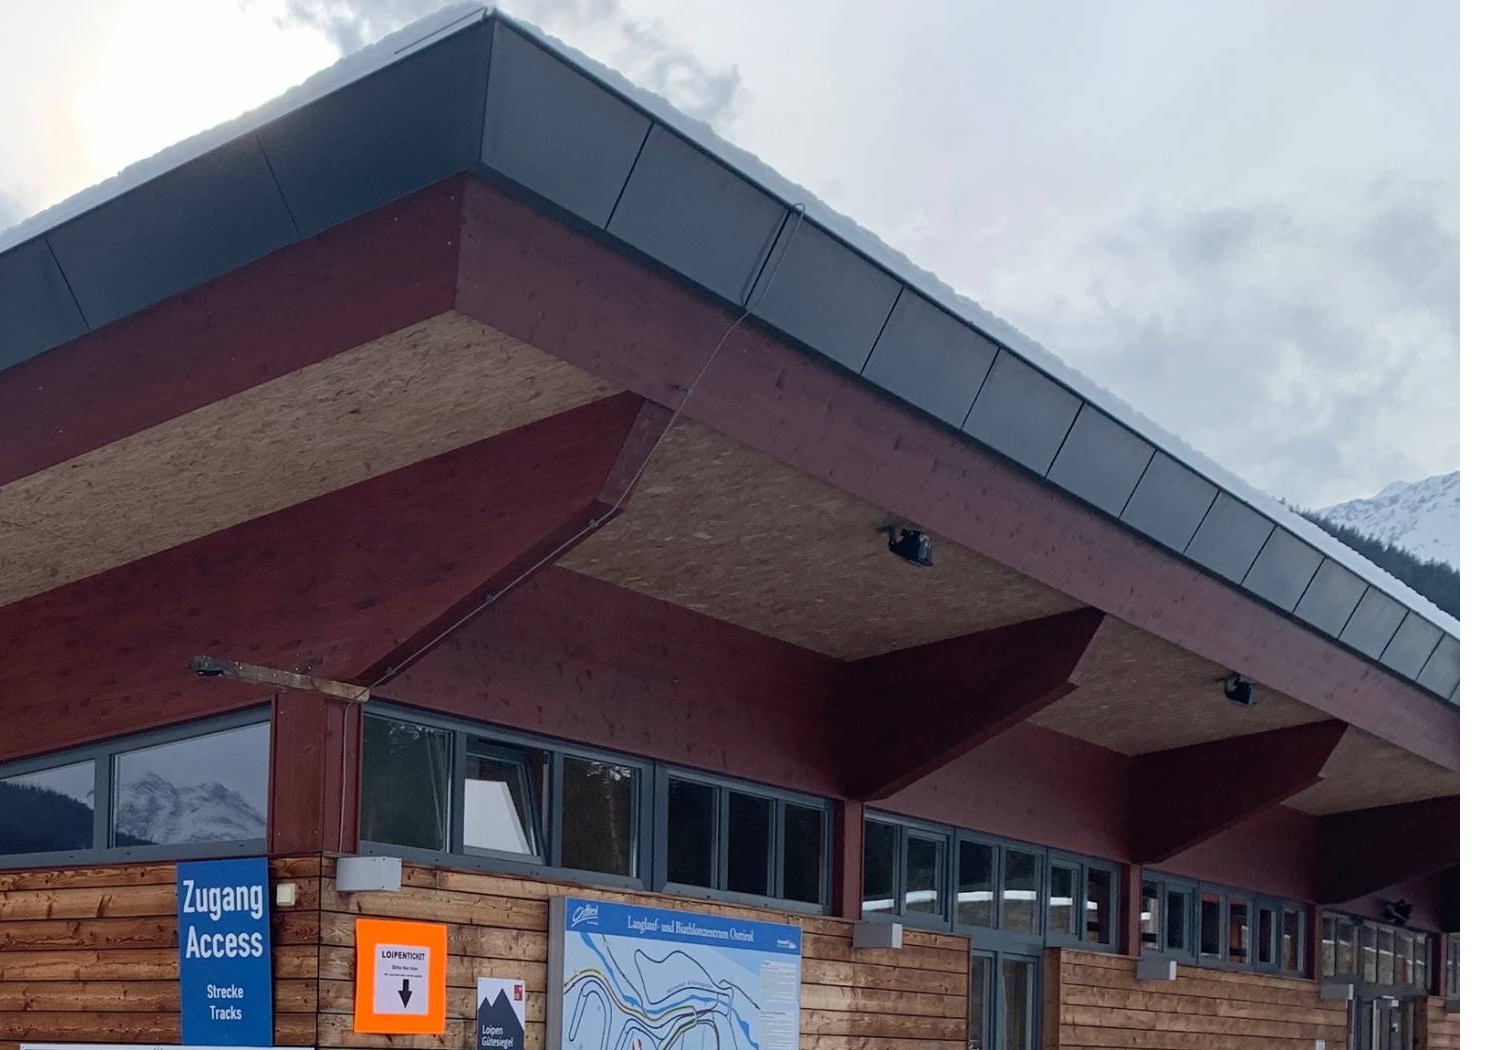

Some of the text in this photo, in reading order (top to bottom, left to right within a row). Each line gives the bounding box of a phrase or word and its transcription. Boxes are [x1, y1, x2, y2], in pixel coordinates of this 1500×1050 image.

[183, 880, 263, 921] Zugang
[627, 915, 660, 934] Langlauf-
[661, 920, 674, 933] und
[675, 921, 729, 939] Biathlonzentrum
[185, 926, 263, 959] Access
[381, 951, 425, 961] LOIPENTICKET
[207, 984, 244, 999] Strecke
[209, 1005, 242, 1020] Tracks
[482, 1025, 503, 1036] Loipen
[482, 1037, 514, 1049] Gütesiegel
